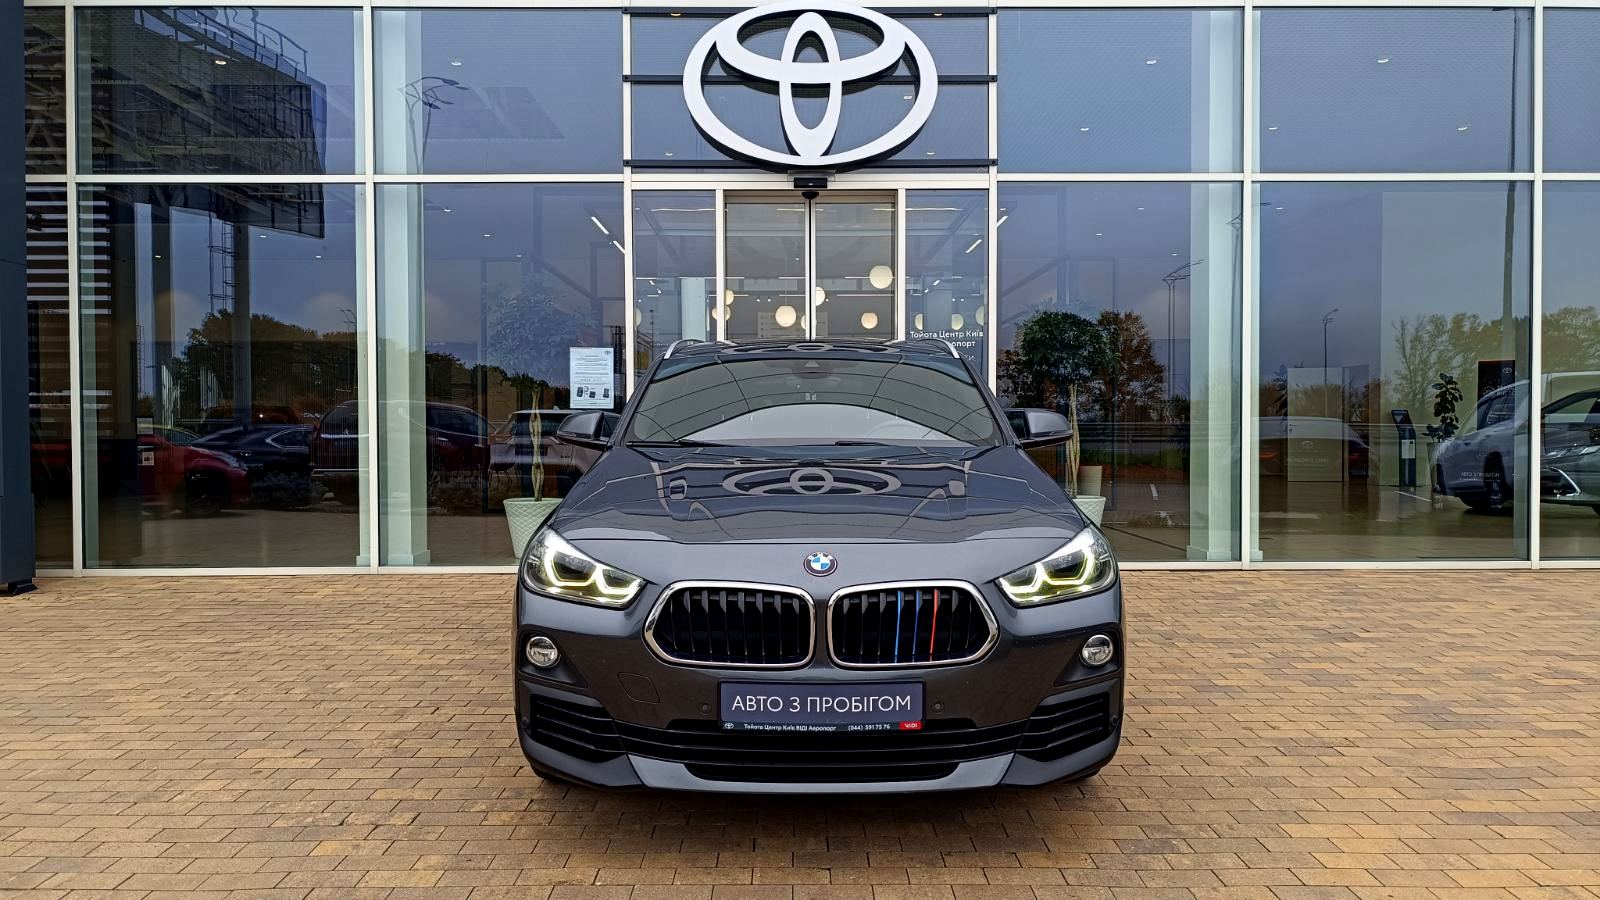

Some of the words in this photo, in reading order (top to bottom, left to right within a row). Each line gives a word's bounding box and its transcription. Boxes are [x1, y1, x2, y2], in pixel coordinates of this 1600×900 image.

[939, 331, 964, 339] Центр
[732, 695, 783, 712] АВТО
[789, 696, 800, 712] З
[807, 695, 911, 712] ПРОБІГОМ
